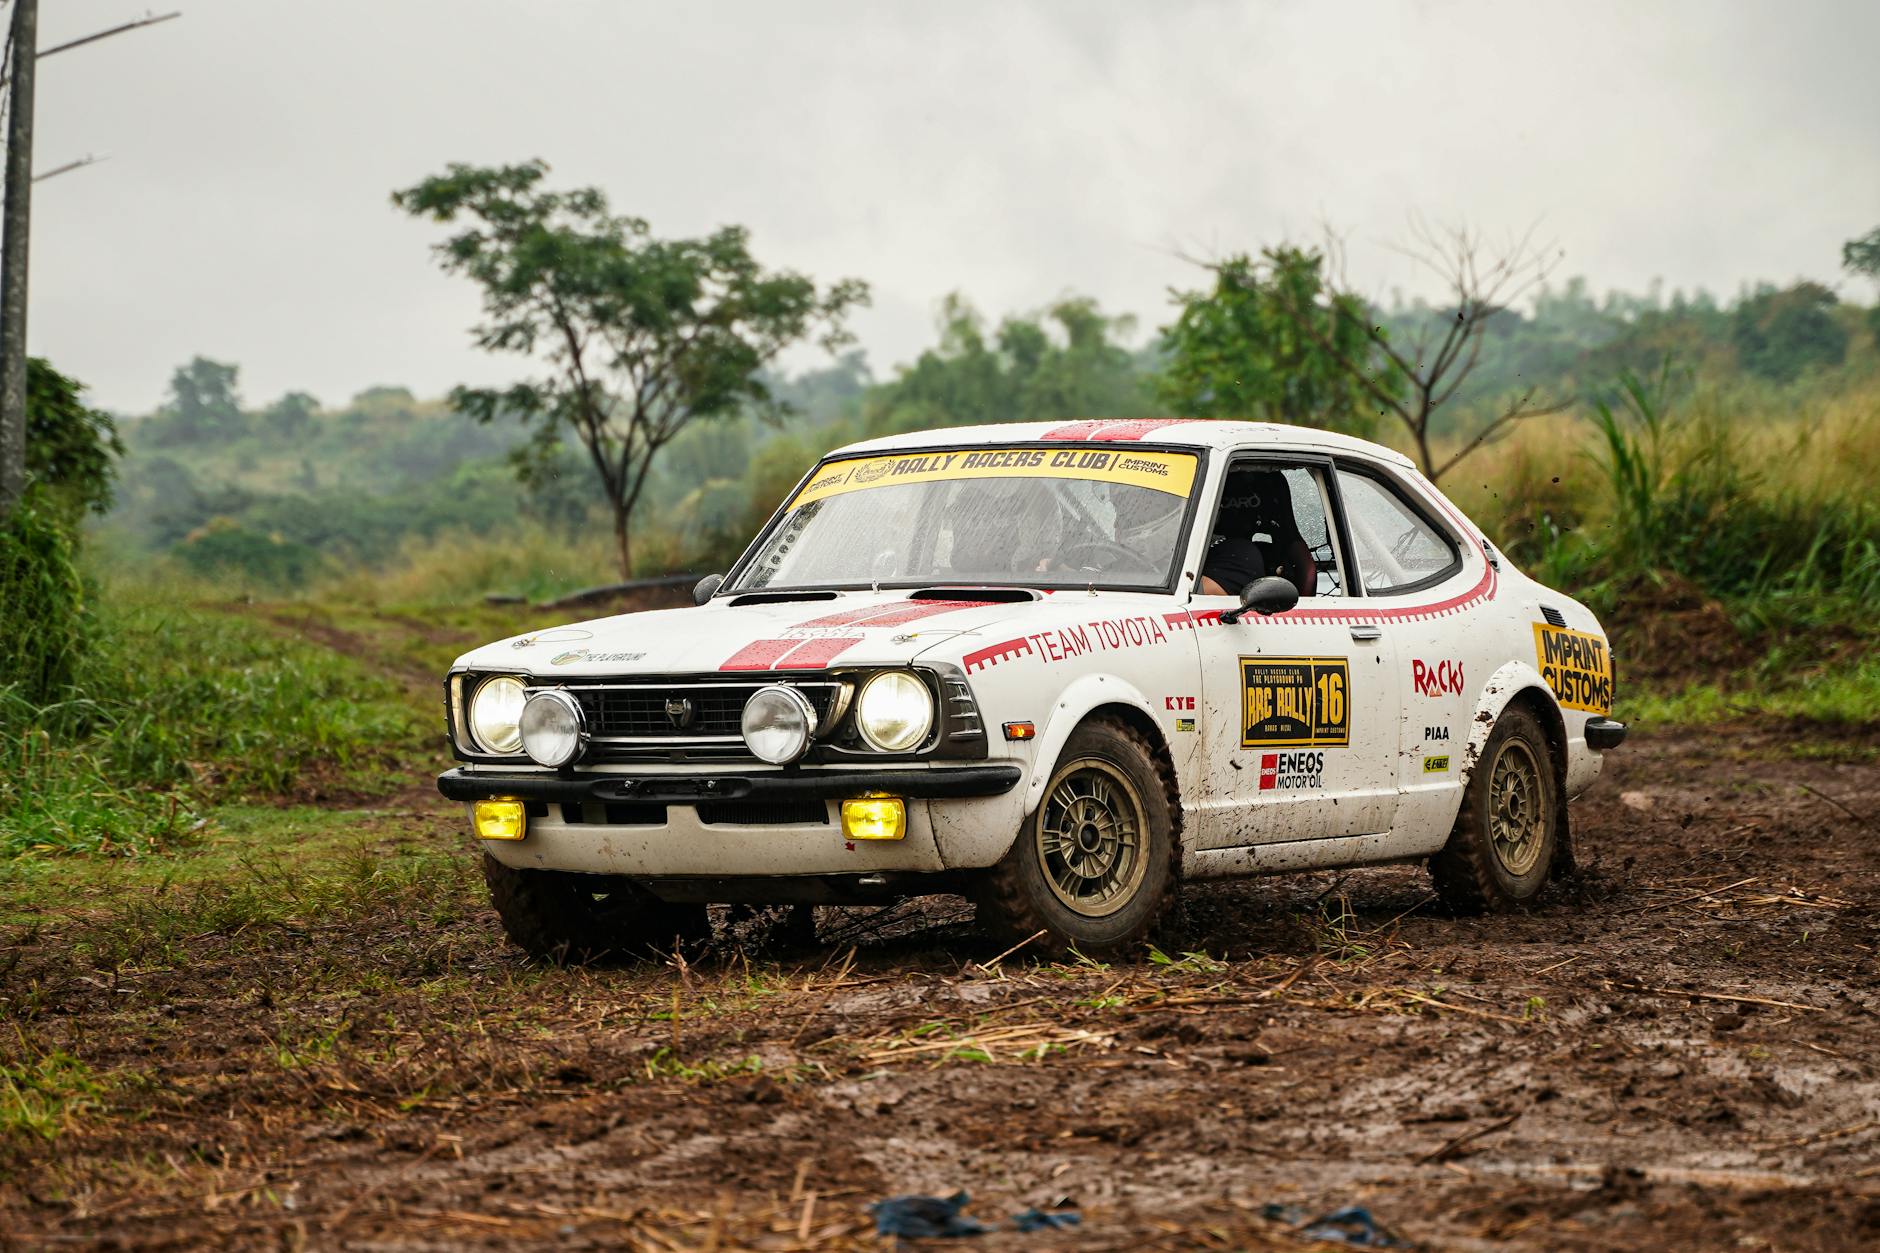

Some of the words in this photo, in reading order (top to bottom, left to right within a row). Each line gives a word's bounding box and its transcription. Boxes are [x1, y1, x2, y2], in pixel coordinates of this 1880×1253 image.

[891, 455, 959, 476] RALLY
[961, 451, 1046, 469] RACERS
[1050, 451, 1110, 470] CLUB
[1118, 463, 1169, 477] CUSTOMS
[1124, 458, 1169, 470] IMPRINT
[1028, 624, 1093, 663] TEAM
[1088, 616, 1167, 651] TOYOTA
[1542, 629, 1603, 673] IMPRINT
[1252, 675, 1262, 684] THE
[1264, 675, 1295, 684] PLAYGROUND
[1412, 659, 1464, 697] RACKS
[1542, 666, 1610, 709] CUSTOMS
[1165, 696, 1195, 710] KYB
[1276, 687, 1313, 727] RALLY
[1317, 673, 1344, 725] 16
[1425, 726, 1449, 740] PIAA
[1261, 767, 1276, 776] ENEOS
[1278, 752, 1324, 774] ENEOS
[1277, 775, 1307, 789] MOTOR
[1309, 774, 1322, 788] OIL
